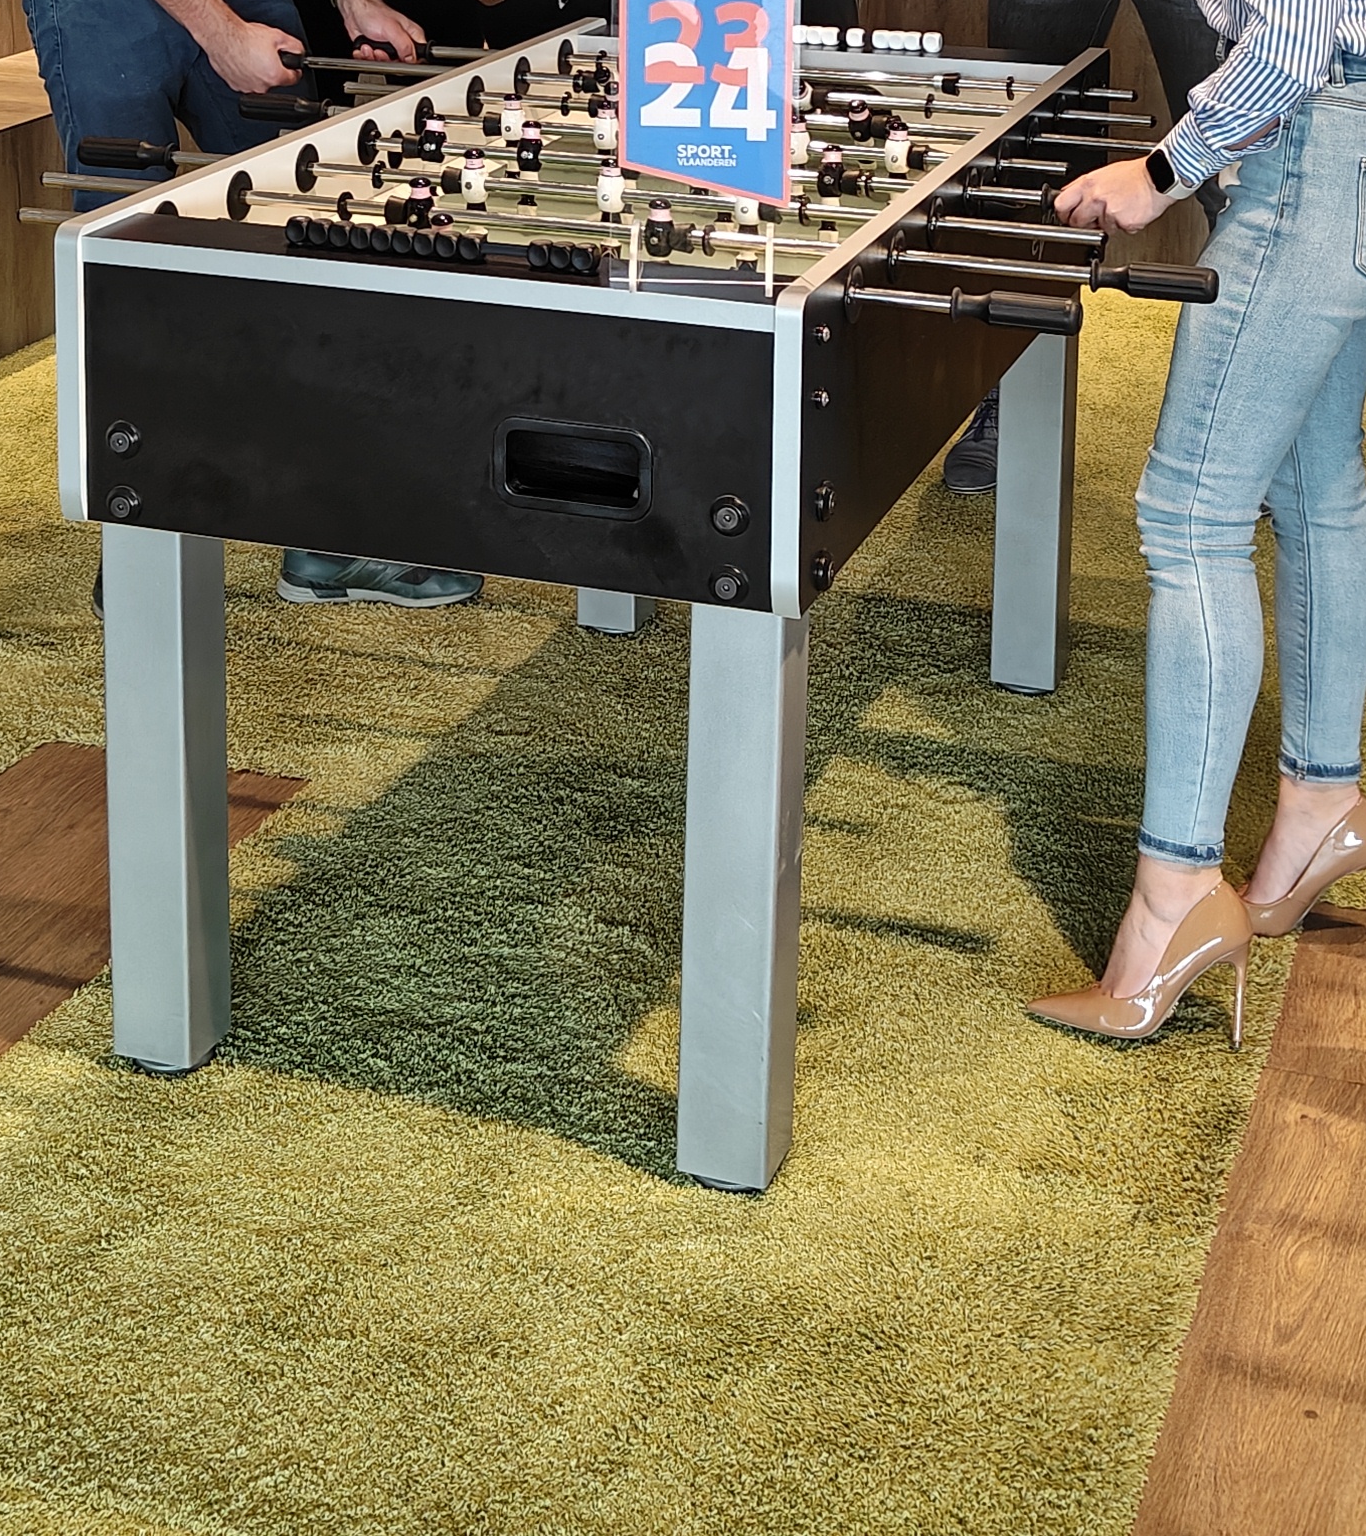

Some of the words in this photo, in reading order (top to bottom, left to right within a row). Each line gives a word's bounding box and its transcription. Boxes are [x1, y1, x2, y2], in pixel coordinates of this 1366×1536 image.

[644, 0, 772, 87] 23
[639, 41, 778, 142] 24
[676, 144, 737, 159] SPORT.
[677, 158, 737, 167] VLAANDEREN
